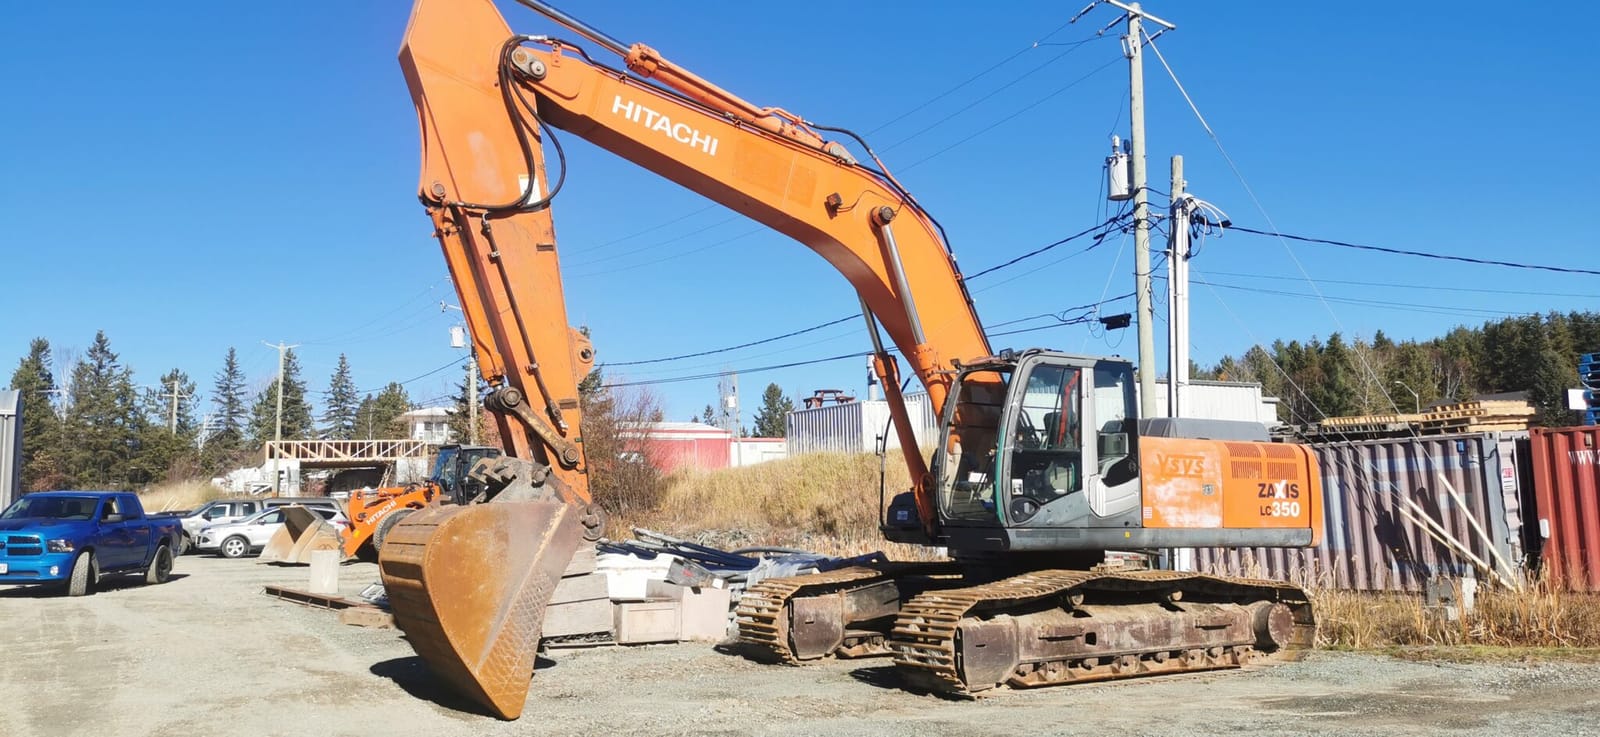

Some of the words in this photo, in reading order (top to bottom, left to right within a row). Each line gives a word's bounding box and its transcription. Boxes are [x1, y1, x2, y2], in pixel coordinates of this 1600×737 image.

[611, 95, 719, 156] HITACHI
[1257, 480, 1299, 499] ZAXIS
[366, 500, 397, 525] HITACHI
